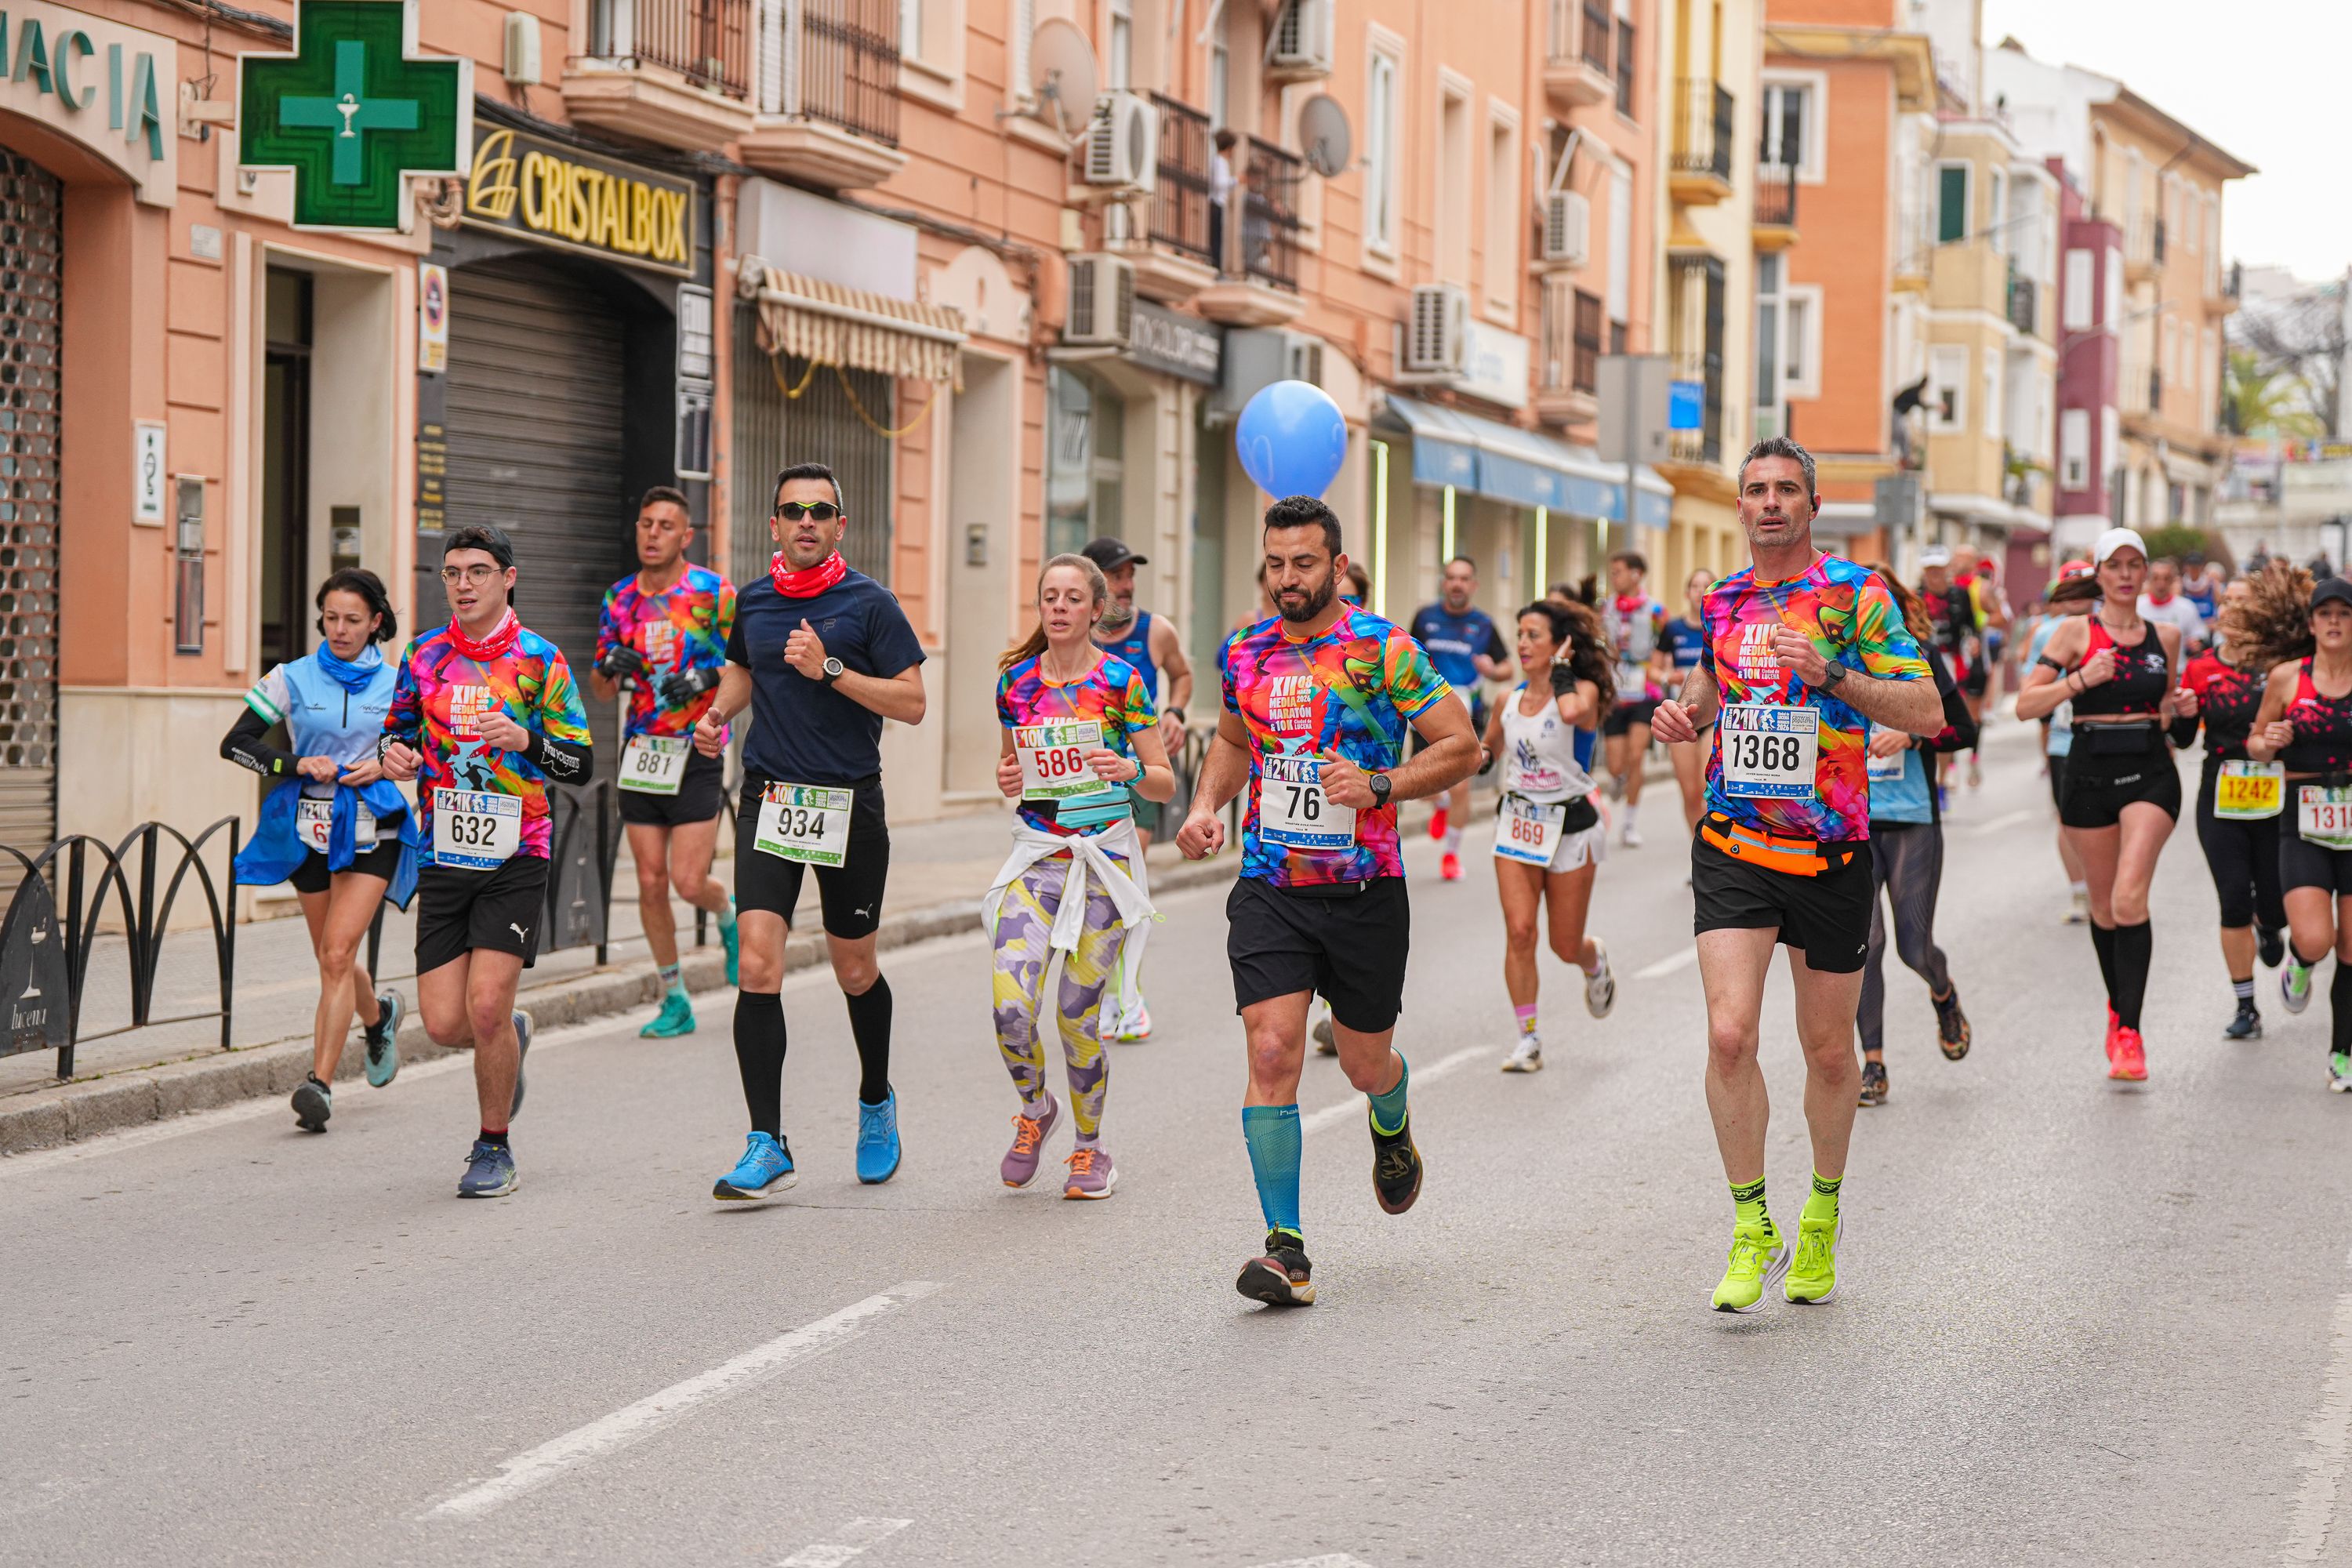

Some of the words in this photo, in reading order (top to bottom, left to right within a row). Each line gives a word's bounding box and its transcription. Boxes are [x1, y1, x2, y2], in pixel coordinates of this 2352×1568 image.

[520, 151, 688, 263] CRISTALBOX
[1741, 623, 1770, 644] XII
[1739, 645, 1766, 655] MEDIA
[1298, 675, 1313, 688] 08
[1737, 670, 1743, 679] &
[1744, 668, 1760, 679] 10K
[451, 685, 477, 704] XII
[1270, 676, 1298, 697] XII
[451, 704, 476, 714] MEDIA
[1269, 697, 1297, 708] MEDIA
[1269, 705, 1312, 720] MARATÓN
[450, 714, 478, 725] MARAT
[1271, 723, 1276, 731] &
[1276, 720, 1294, 731] 10K
[1733, 708, 1759, 730] 21K
[455, 725, 470, 735] 10K
[1021, 729, 1048, 747] 10K
[637, 752, 671, 775] 881
[1035, 747, 1082, 778] 586
[1733, 735, 1800, 771] 1368
[1272, 759, 1300, 782] 21K
[773, 786, 797, 804] 10K
[2228, 779, 2273, 800] 1242
[307, 803, 330, 819] 21K
[446, 792, 471, 812] 21K
[1287, 786, 1319, 820] 76
[778, 808, 825, 840] 934
[2310, 805, 2352, 829] 131
[452, 815, 496, 846] 632
[1512, 817, 1544, 846] 869
[12, 1004, 47, 1030] lucena
